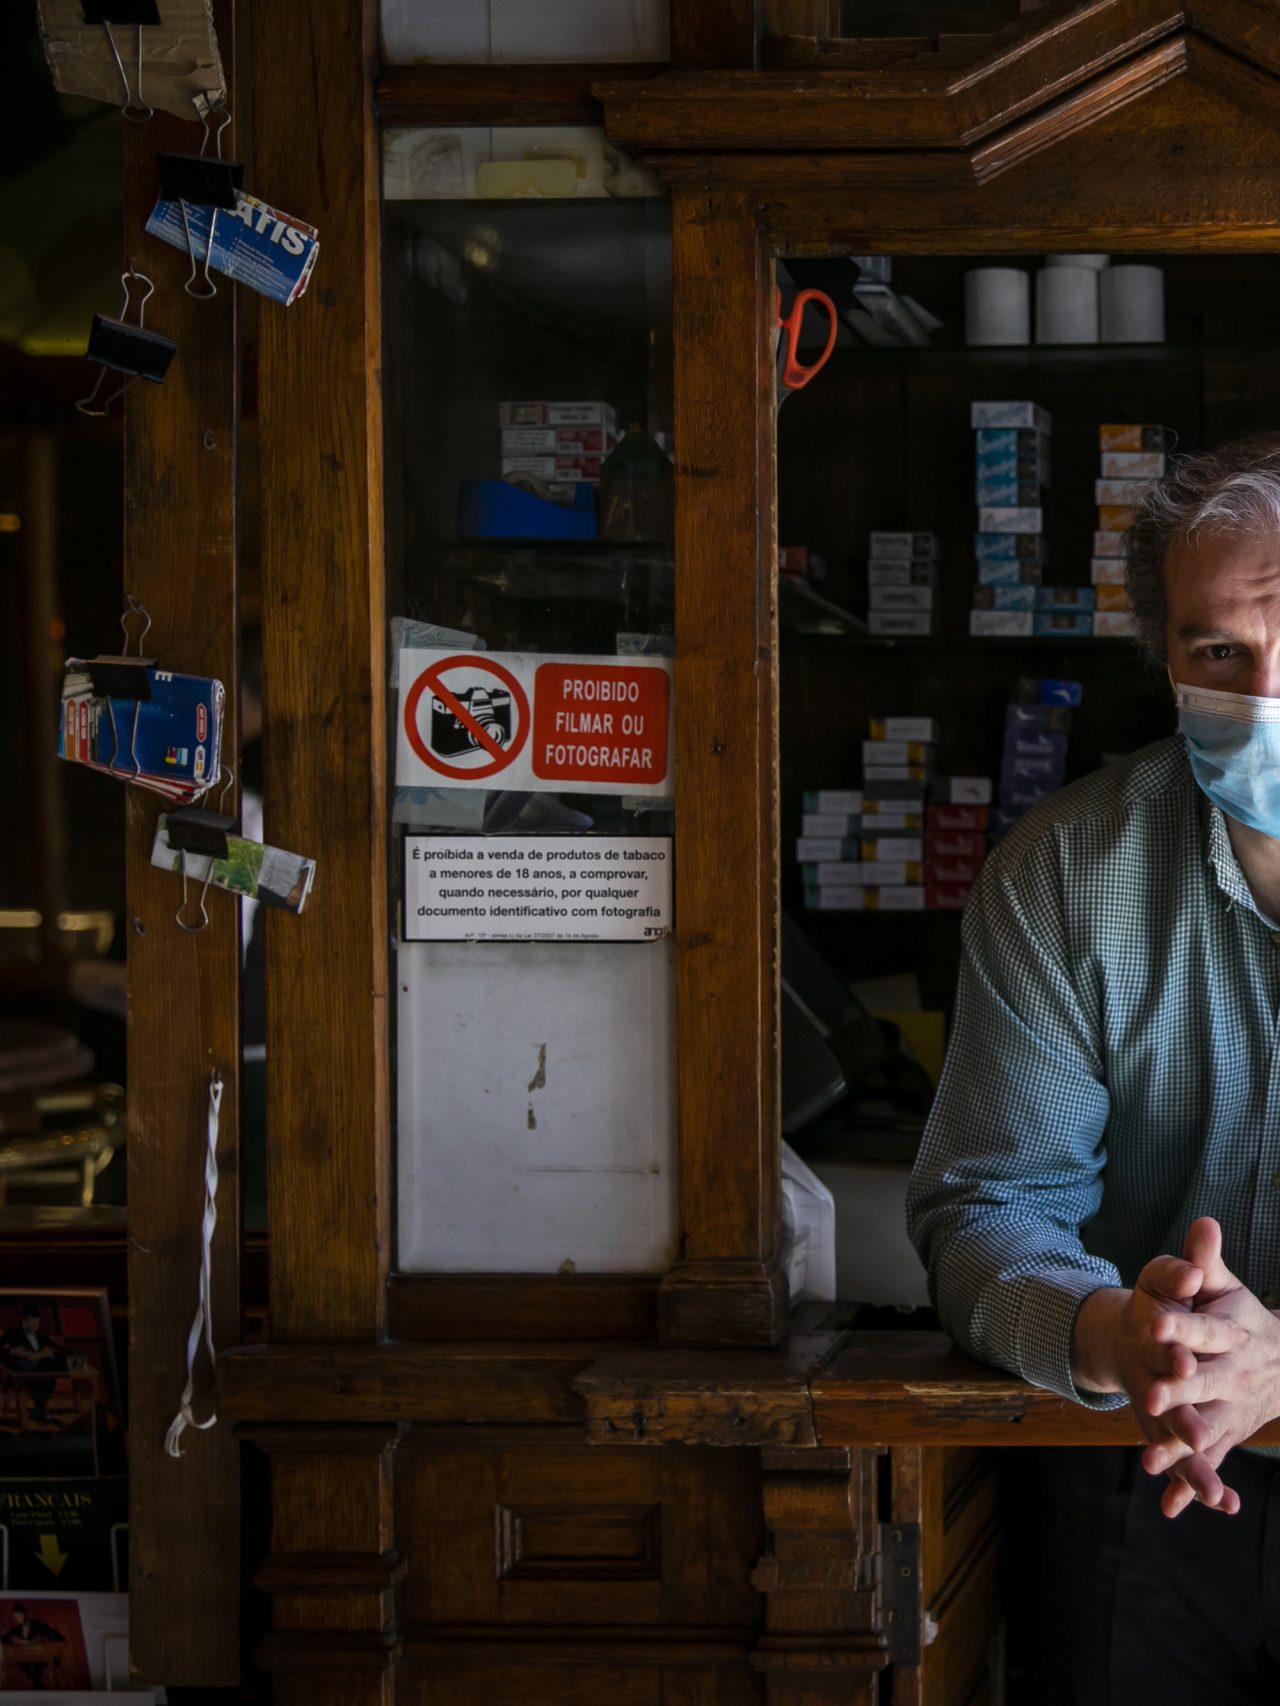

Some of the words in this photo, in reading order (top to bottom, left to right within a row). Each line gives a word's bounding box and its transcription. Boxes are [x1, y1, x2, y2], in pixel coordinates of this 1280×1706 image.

[223, 205, 309, 256] ATIS
[562, 679, 640, 702] PROIBIDO
[555, 711, 614, 735] FILMAR
[621, 713, 645, 736] OU
[544, 743, 654, 769] FOTOGRAFAR
[412, 846, 421, 860] É
[477, 851, 485, 860] a
[487, 849, 525, 860] venda
[528, 849, 543, 860] de
[546, 849, 601, 862] produtos
[604, 849, 620, 860] de
[623, 849, 666, 860] tabaco
[429, 870, 437, 879] a
[440, 870, 493, 879] menores
[496, 868, 512, 879] de
[516, 868, 530, 879] 18
[532, 870, 566, 881] anos,
[569, 870, 577, 879] a
[580, 870, 648, 881] comprovar,
[439, 887, 485, 900] quando
[487, 886, 558, 899] necessário,
[561, 889, 582, 900] por
[585, 887, 639, 900] qualquer
[417, 905, 487, 917] documento
[489, 905, 568, 917] identificativo
[571, 907, 598, 917] com
[601, 906, 661, 919] fotografia
